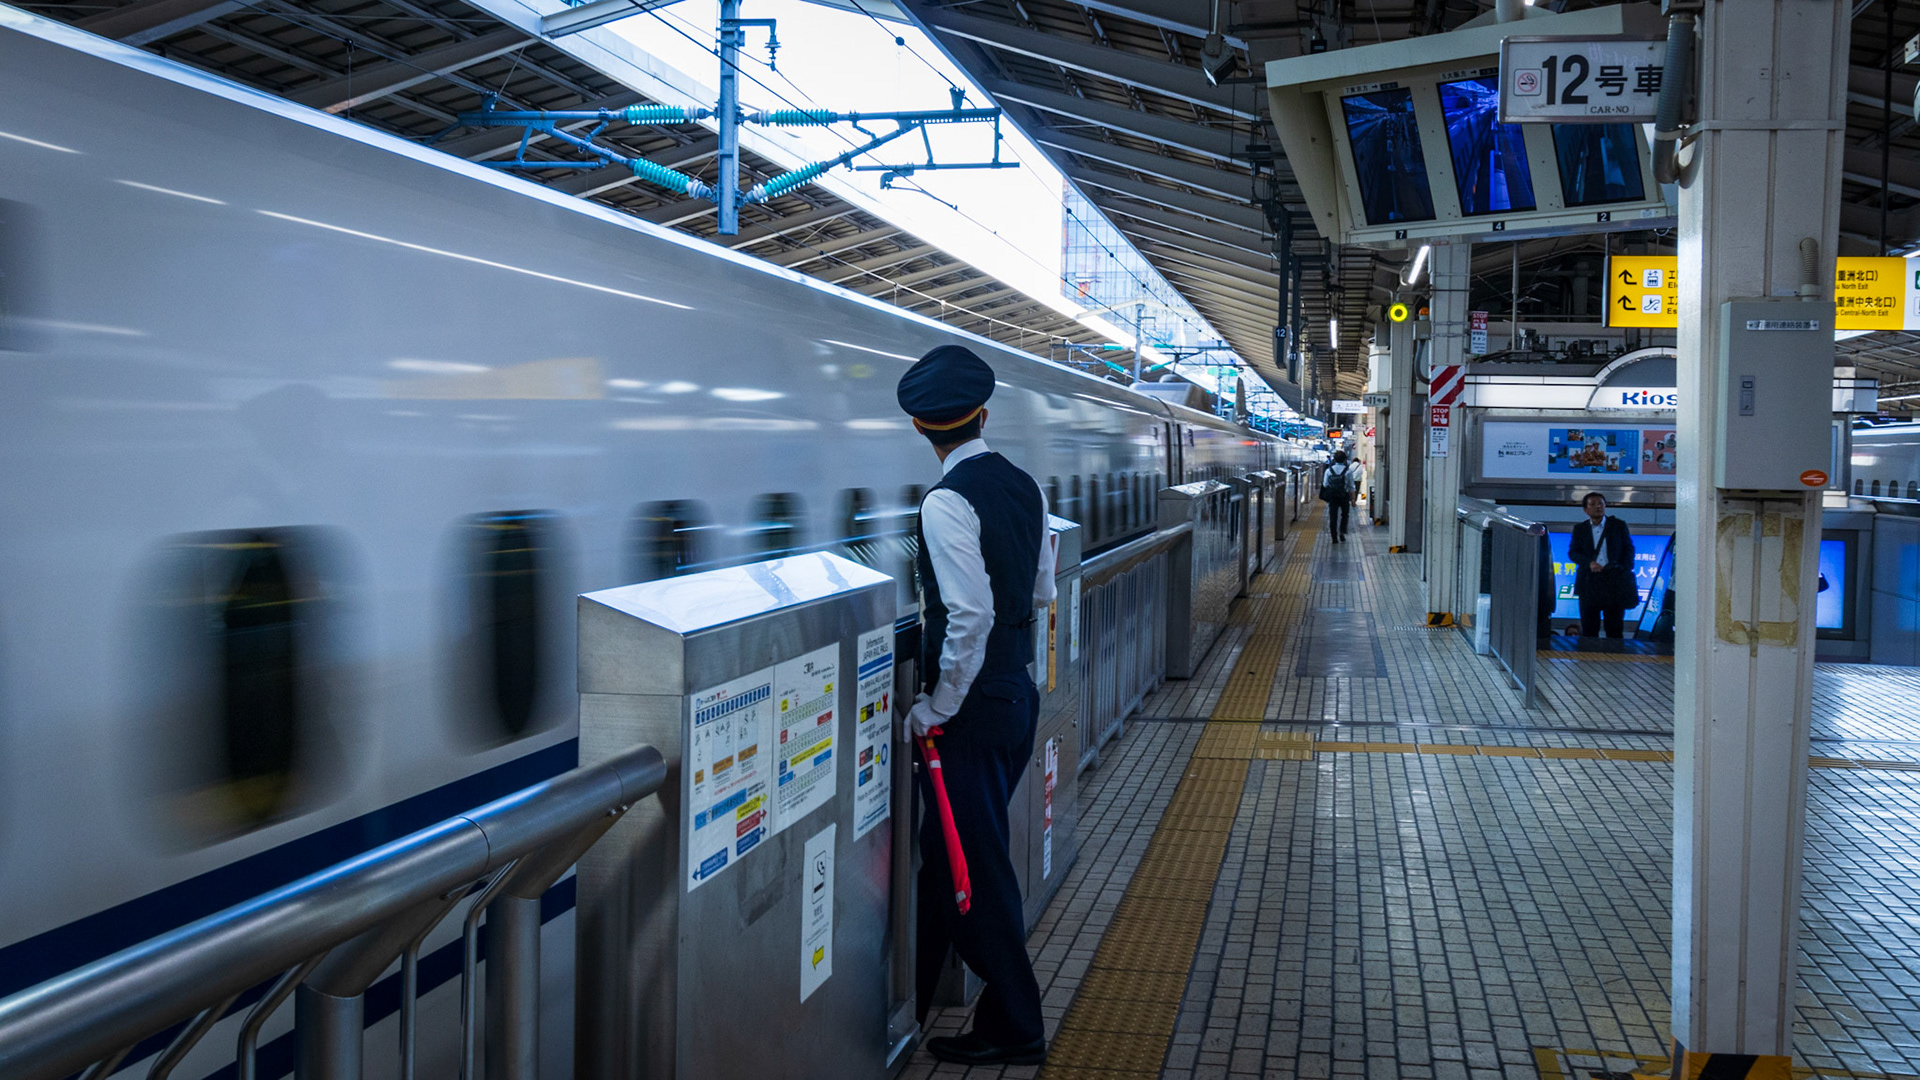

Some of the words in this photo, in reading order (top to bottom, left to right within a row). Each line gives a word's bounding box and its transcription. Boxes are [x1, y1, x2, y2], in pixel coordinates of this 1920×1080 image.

[1600, 212, 1607, 222] 2
[1495, 222, 1502, 231] 4
[1398, 230, 1405, 240] 7
[1840, 309, 1877, 317] Central-North
[1878, 309, 1889, 317] Exit
[1276, 328, 1286, 338] 12
[1290, 352, 1297, 360] 11
[1622, 390, 1678, 406] Kios
